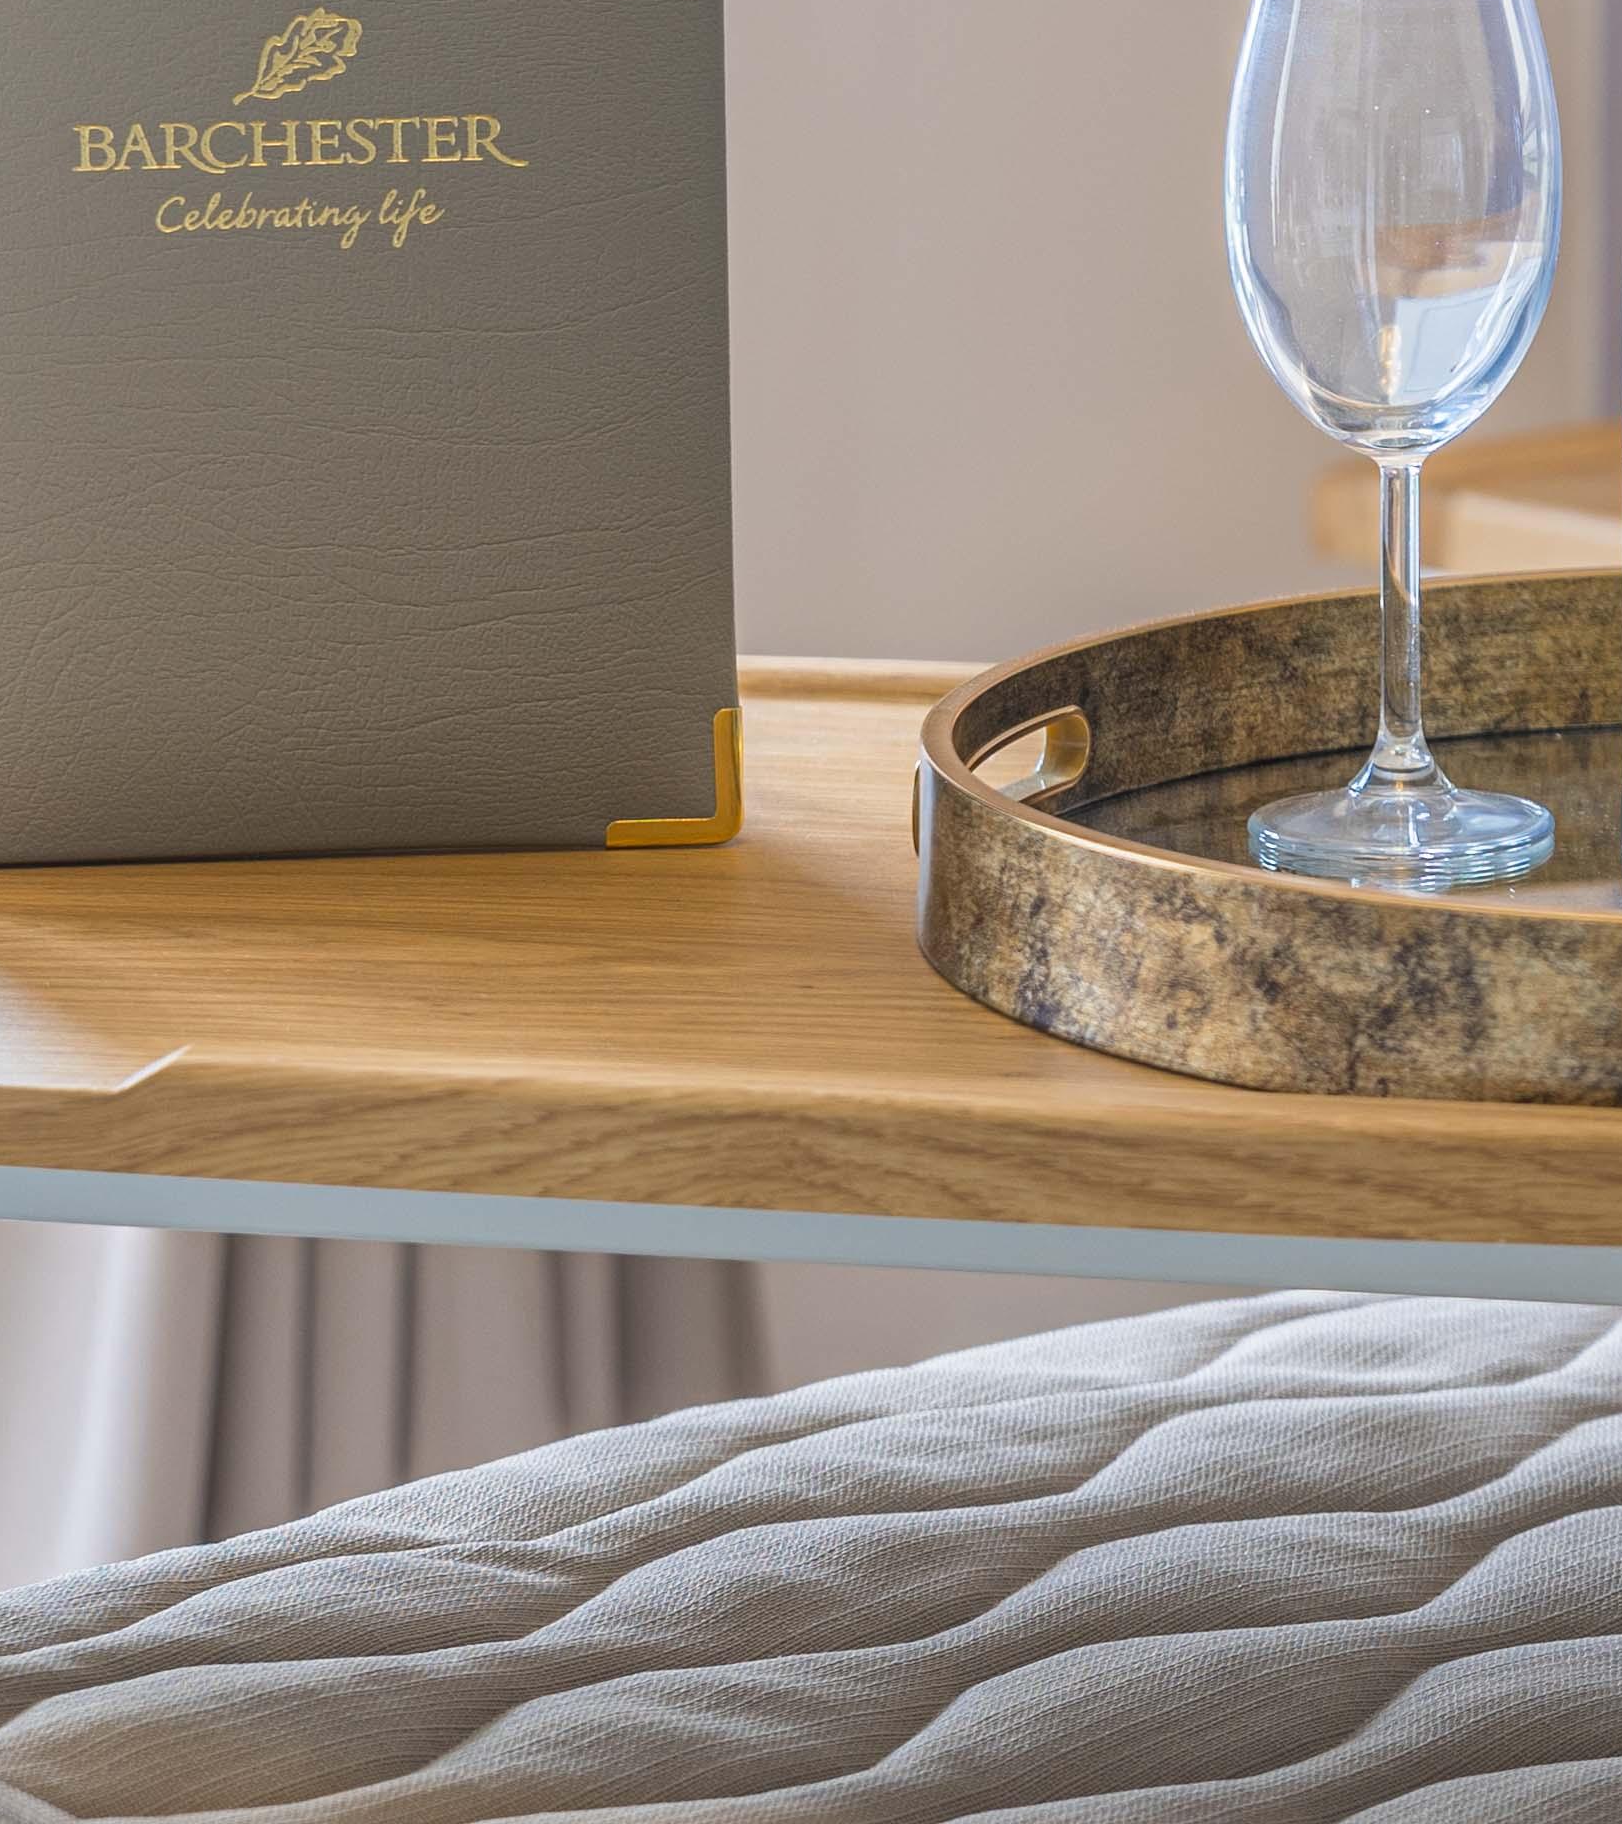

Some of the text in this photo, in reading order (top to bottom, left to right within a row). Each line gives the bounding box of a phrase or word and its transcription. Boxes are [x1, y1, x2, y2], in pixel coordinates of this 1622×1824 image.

[73, 114, 529, 174] BARCHESTER
[155, 188, 446, 249] Celebrating life
